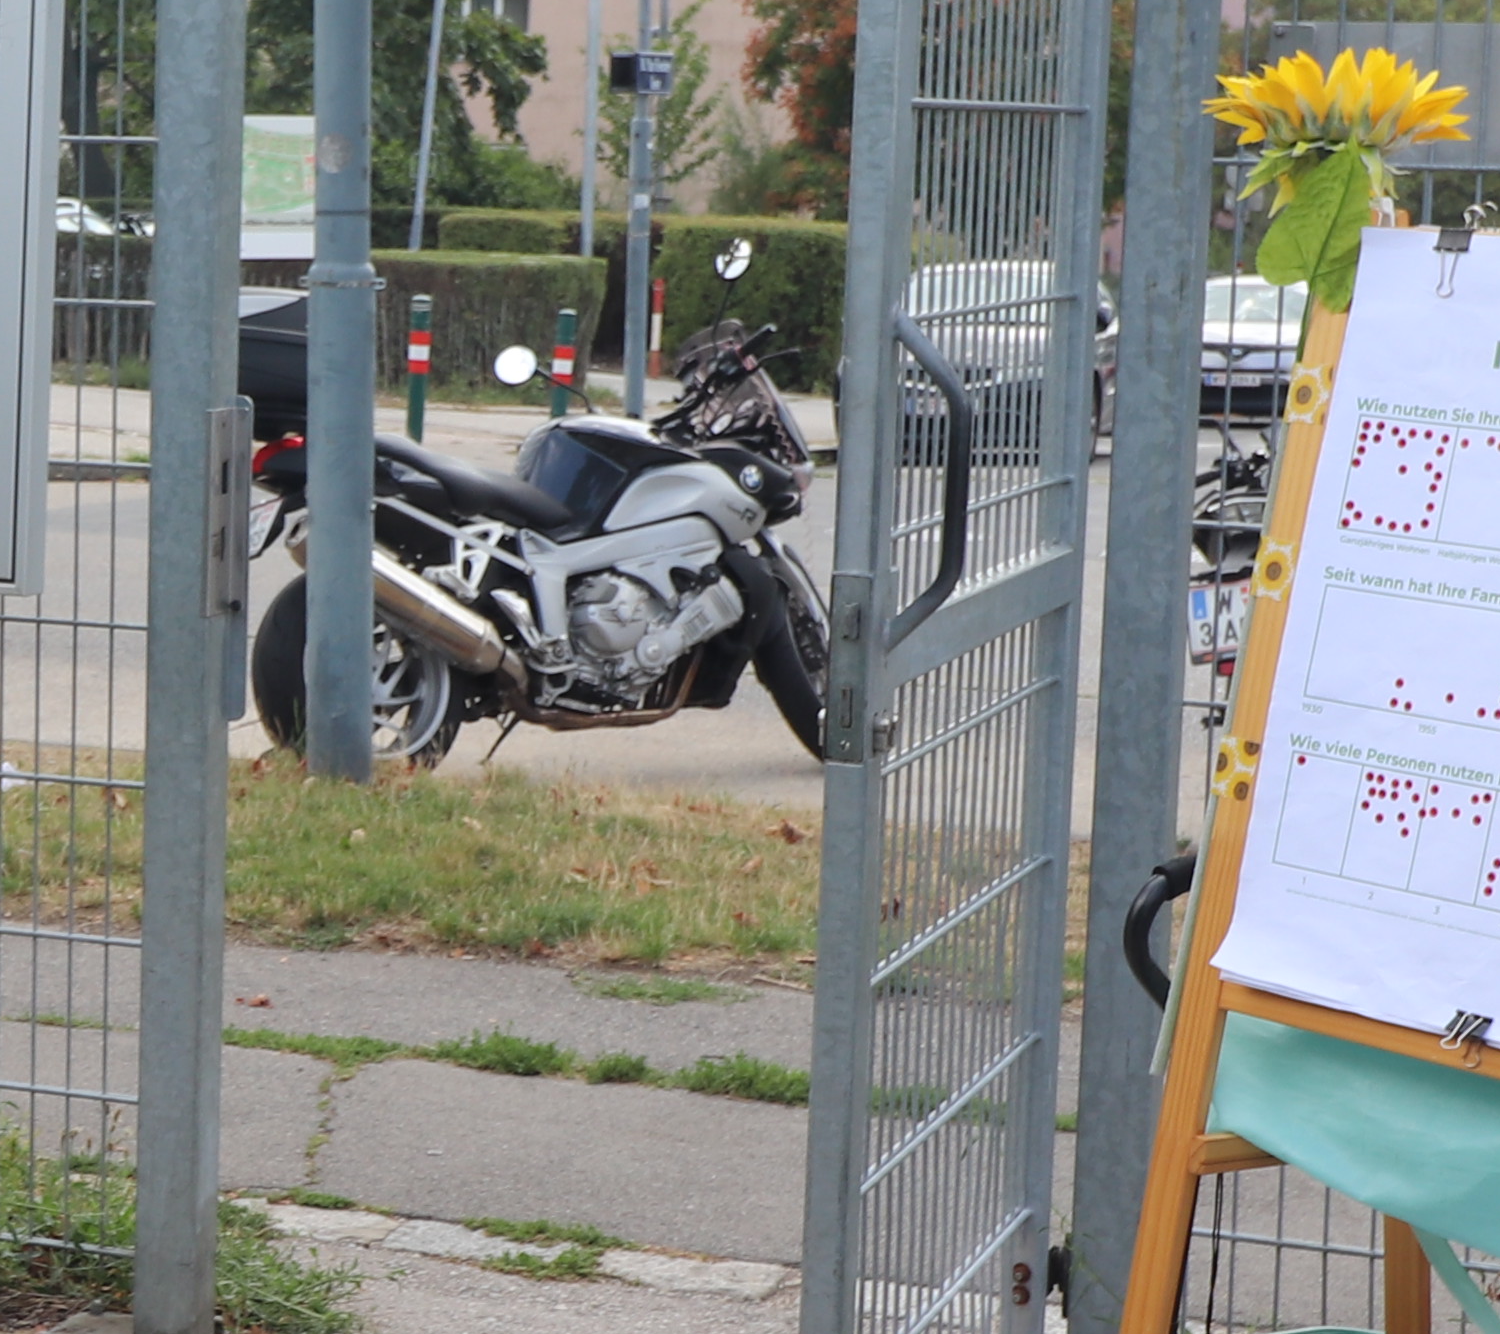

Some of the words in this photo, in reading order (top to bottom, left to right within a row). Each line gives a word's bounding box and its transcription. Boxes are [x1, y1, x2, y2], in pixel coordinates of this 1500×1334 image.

[1357, 397, 1389, 414] Wie
[1392, 402, 1446, 421] nutzen
[1451, 408, 1475, 424] Sie
[1339, 534, 1395, 554] Ganzjähriges
[1397, 542, 1431, 556] Wohnen
[1437, 548, 1487, 565] Halbjähriges
[1323, 565, 1355, 583] Seit
[1358, 572, 1404, 592] wann
[1408, 576, 1434, 596] hat
[1436, 581, 1467, 601] Ihre
[1301, 703, 1323, 716] 1930
[1418, 724, 1437, 736] 1955
[1289, 733, 1322, 752] Wie
[1324, 740, 1362, 759] viele
[1365, 747, 1437, 774] Personen
[1439, 762, 1495, 785] nutzen
[1367, 891, 1374, 901] 2
[1433, 906, 1441, 915] 3
